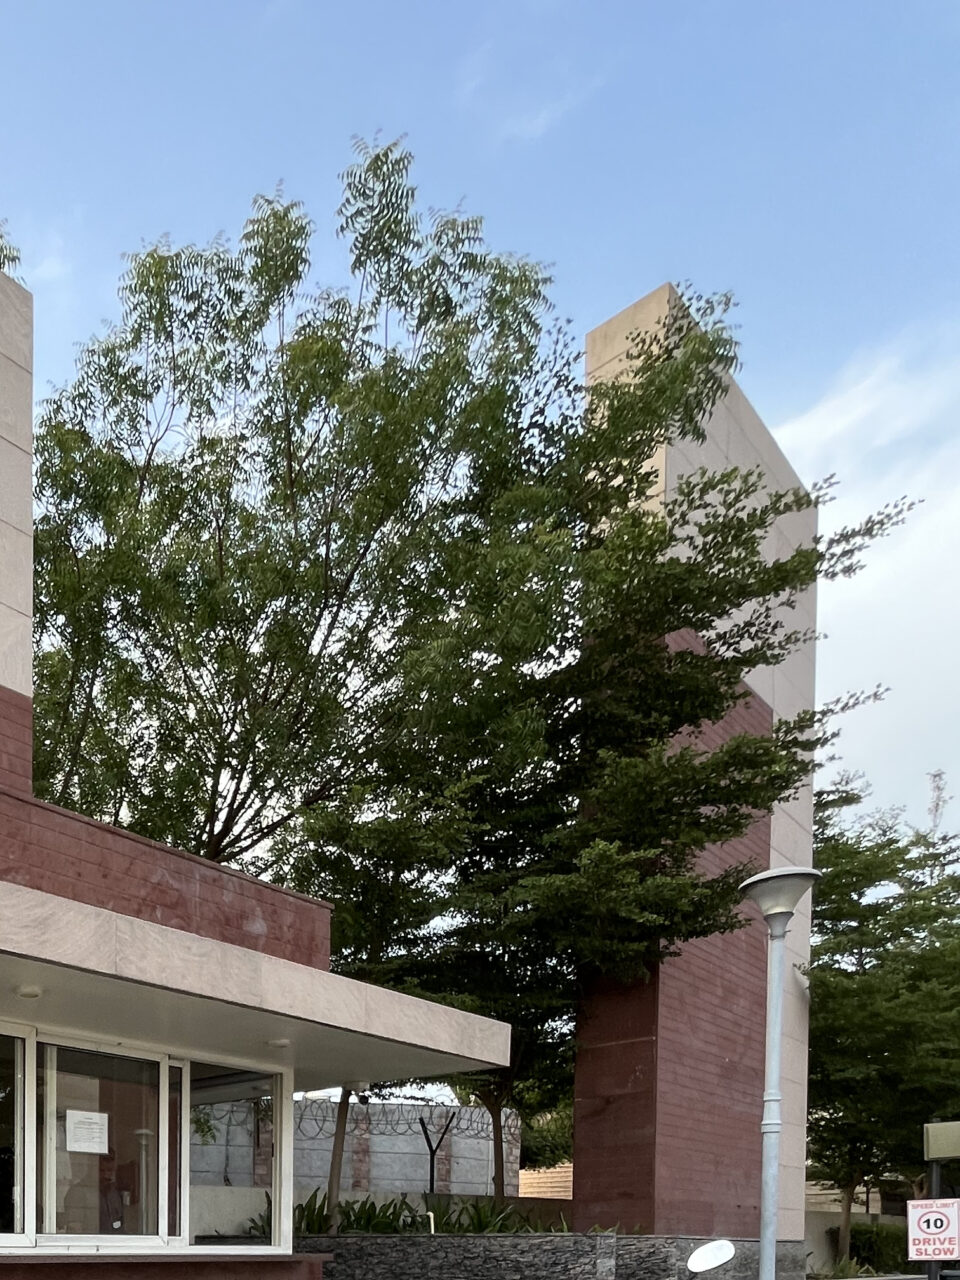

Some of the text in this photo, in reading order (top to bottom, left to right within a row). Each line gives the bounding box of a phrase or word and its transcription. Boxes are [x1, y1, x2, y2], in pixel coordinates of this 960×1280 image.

[923, 1218, 944, 1229] 10
[912, 1237, 957, 1246] DRIVE
[915, 1248, 955, 1256] SLOW
